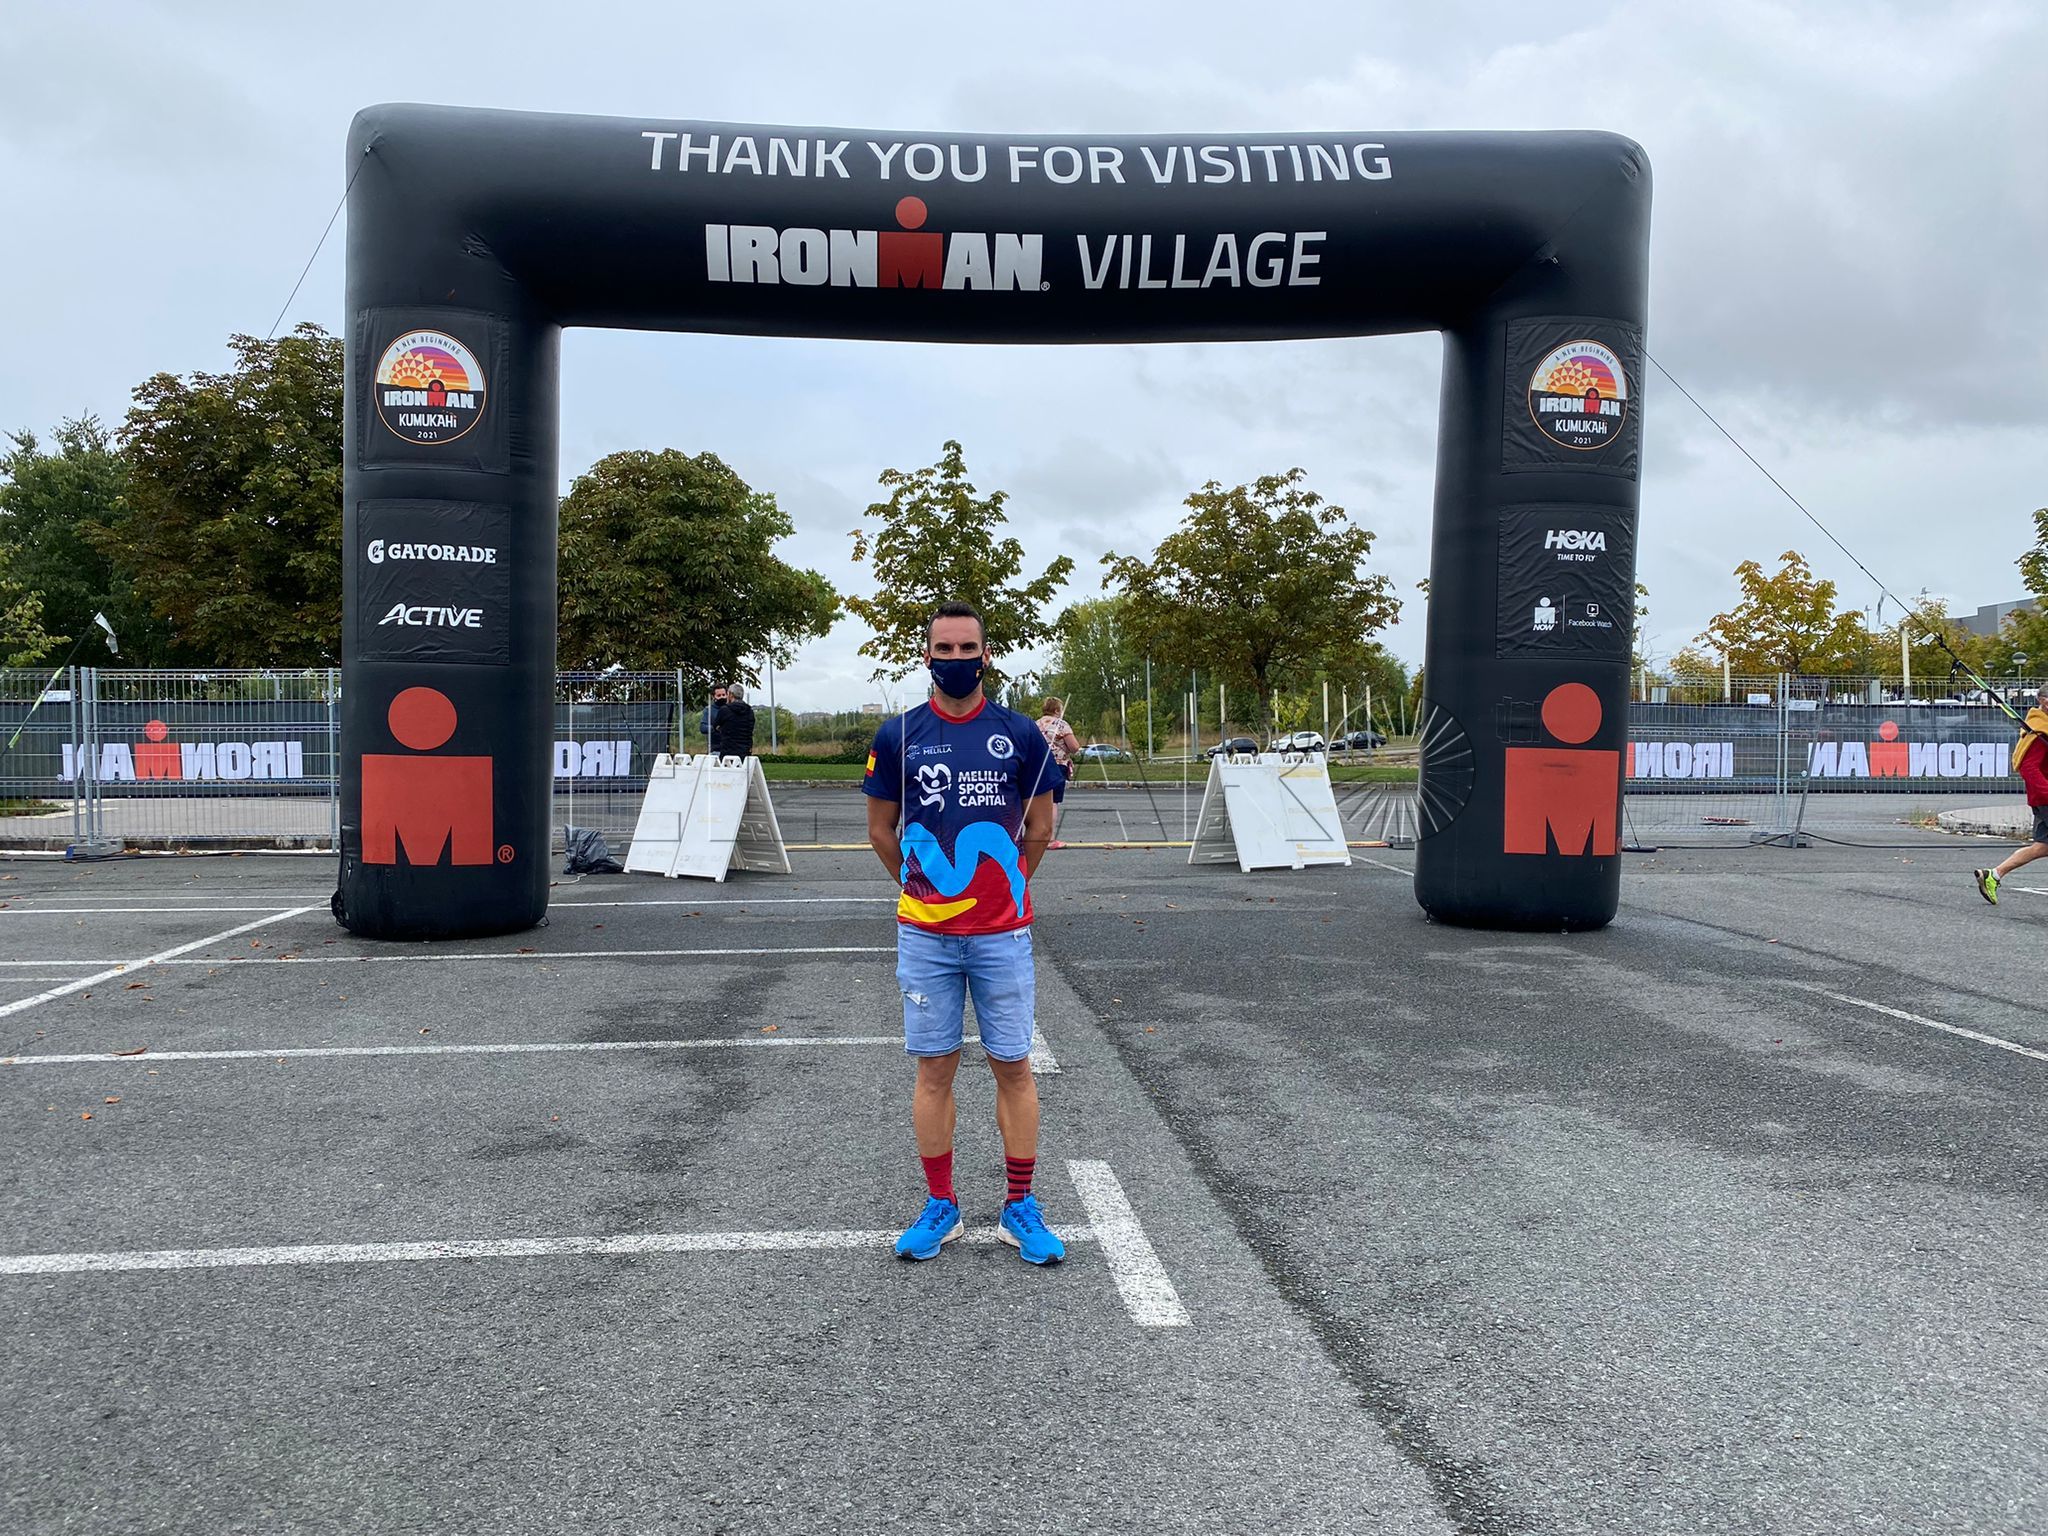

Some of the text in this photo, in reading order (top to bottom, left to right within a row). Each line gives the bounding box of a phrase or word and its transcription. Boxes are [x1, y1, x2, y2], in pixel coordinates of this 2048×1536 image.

[641, 131, 1392, 183] THANK YOU FOR VISITING
[705, 223, 1327, 291] IRONMAN VILLAGE
[384, 390, 475, 410] IRONMAN
[1540, 397, 1621, 416] IRONMAN
[417, 431, 439, 439] 2021
[1573, 436, 1592, 445] 2021
[1544, 530, 1606, 551] HOKA
[388, 543, 497, 564] GATORADE
[1557, 553, 1597, 562] TIME TO FLY
[378, 603, 483, 628] ACTIVE
[1568, 619, 1596, 628] Facebook
[923, 747, 953, 756] MELILLA
[958, 770, 1008, 783] MELILLA
[958, 782, 1000, 795] SPORT
[958, 794, 1007, 807] CAPITAL
